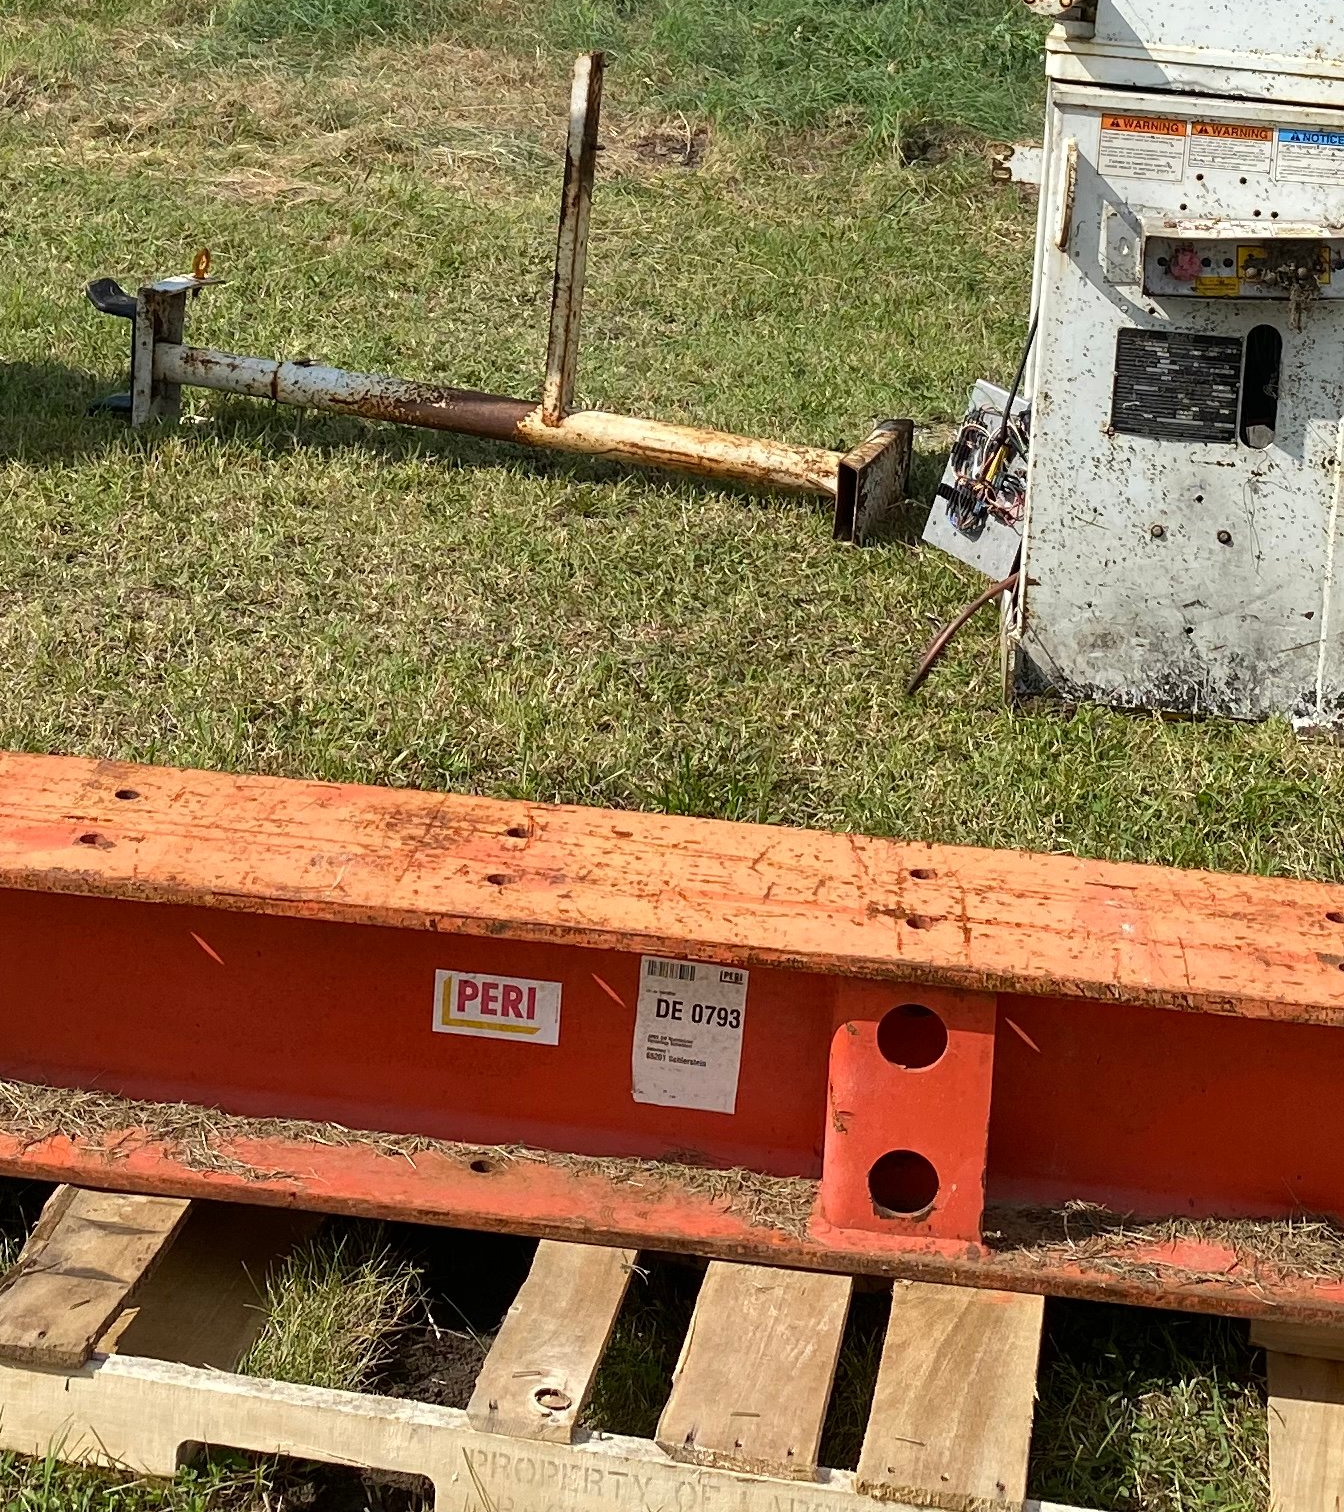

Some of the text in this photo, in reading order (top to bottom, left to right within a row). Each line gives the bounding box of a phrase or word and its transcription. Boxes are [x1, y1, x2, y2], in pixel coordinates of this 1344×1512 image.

[1123, 119, 1179, 133] WARNING
[1212, 125, 1268, 140] WARNING
[1303, 133, 1344, 145] NOTICE
[457, 979, 536, 1021] PERI
[656, 998, 741, 1029] DE 0793
